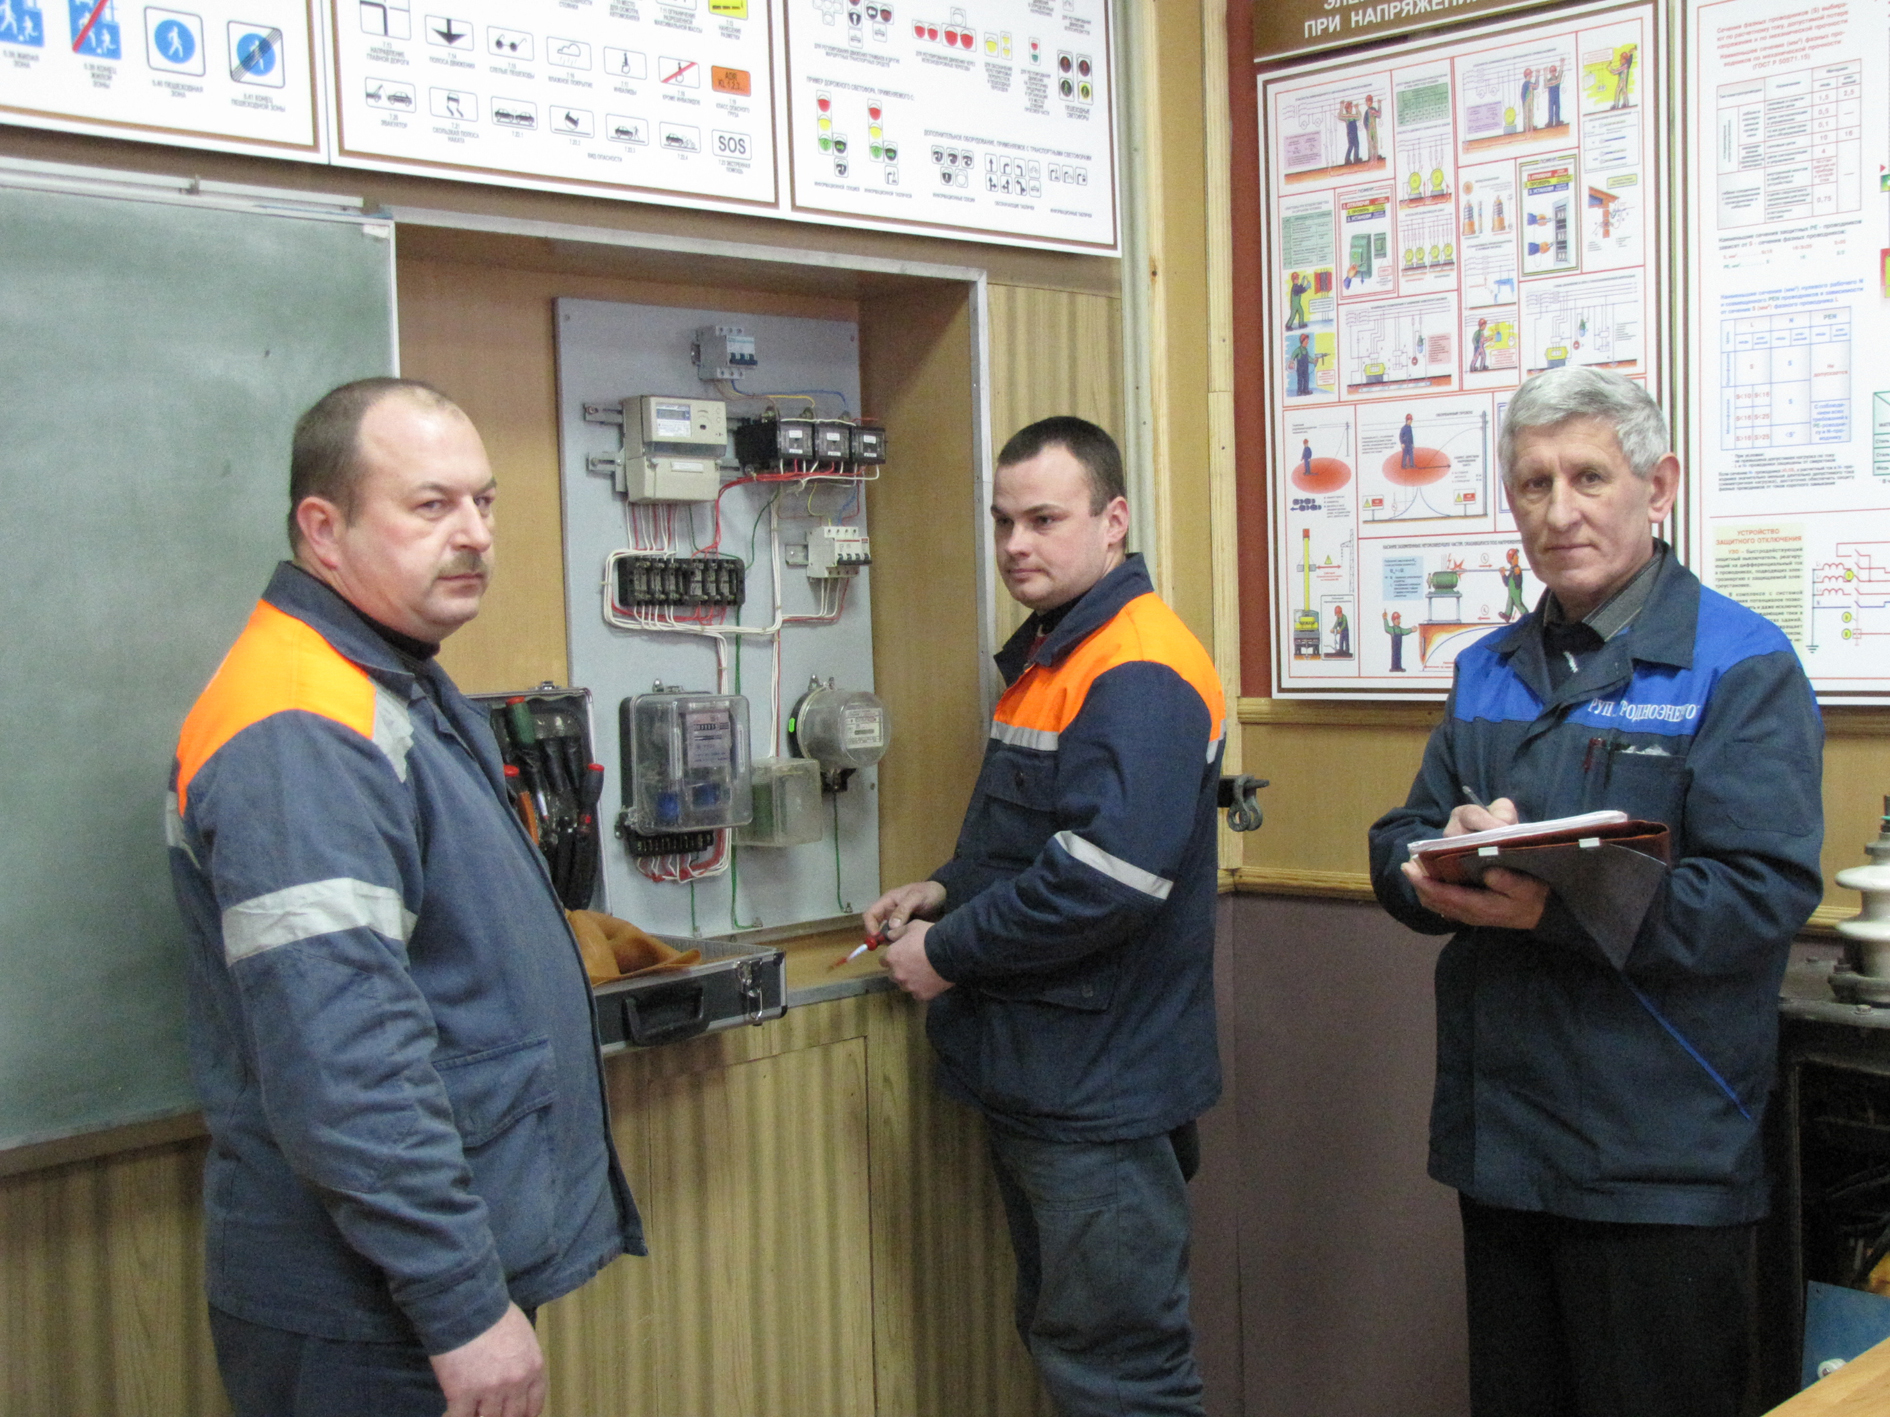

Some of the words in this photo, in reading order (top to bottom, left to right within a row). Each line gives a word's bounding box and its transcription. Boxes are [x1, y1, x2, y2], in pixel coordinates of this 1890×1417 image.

[1304, 14, 1341, 39] ПРИ
[1350, 0, 1478, 29] НАПРЯЖЕ
[1818, 92, 1830, 102] 1,5
[1843, 87, 1856, 97] 2,5
[1817, 106, 1830, 116] 0,5
[1817, 120, 1829, 130] 0,1
[1820, 133, 1829, 141] 10
[717, 134, 747, 156] SOS
[1816, 194, 1833, 204] 0,75
[1823, 312, 1838, 321] PEN
[1737, 528, 1780, 537] УСТРОЙСТВО
[1715, 537, 1756, 546] ЗАЩИТНОГО
[1757, 535, 1802, 545] ОТКЛЮЧЕНИЯ
[1587, 698, 1616, 717] РУП
